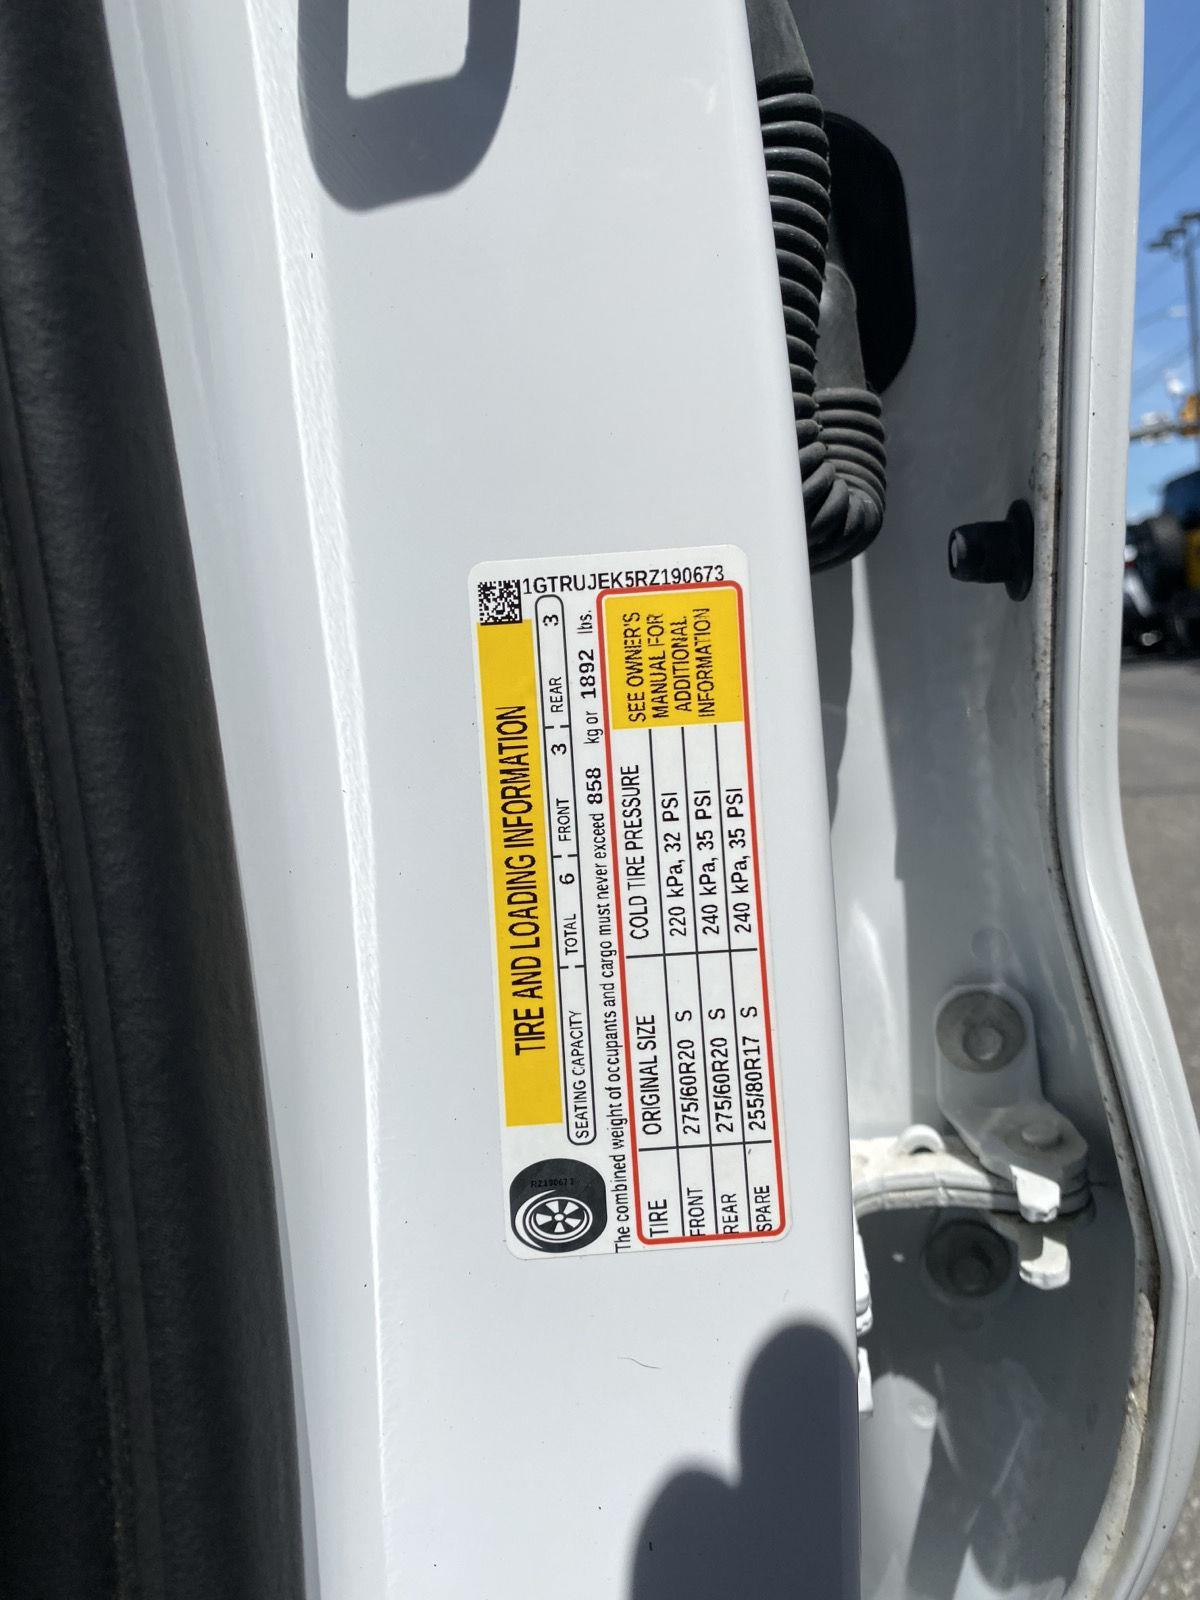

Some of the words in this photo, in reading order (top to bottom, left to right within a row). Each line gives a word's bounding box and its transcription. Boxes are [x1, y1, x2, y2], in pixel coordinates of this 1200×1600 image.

[523, 565, 724, 594] 1GTRUJEK5RZ190673
[543, 614, 559, 626] 3
[577, 610, 593, 635] lbs.
[646, 613, 665, 647] FOR
[622, 611, 645, 687] OWNER'S
[670, 616, 693, 712] ADDITIONAL
[692, 608, 716, 717] INFORMATION
[578, 649, 597, 699] 1892
[649, 650, 669, 718] MANUAL
[549, 676, 563, 713] REAR
[627, 692, 646, 723] SEE
[584, 728, 603, 744] kg
[587, 711, 599, 725] or
[551, 743, 567, 755] 3
[496, 705, 535, 848] INFORMATION
[586, 767, 602, 805] 858
[556, 798, 571, 842] FRONT
[620, 764, 644, 851] PRESSURE
[660, 792, 679, 822] PSI
[694, 790, 712, 820] PSI
[725, 788, 744, 818] PSI
[589, 813, 606, 859] exceed
[664, 832, 681, 853] 32
[697, 830, 714, 851] 35
[729, 828, 746, 848] 35
[559, 873, 575, 885] 6
[594, 862, 609, 900] never
[625, 855, 646, 889] TIRE
[666, 859, 685, 898] kPa,
[699, 858, 718, 896] kPa,
[730, 855, 750, 893] kPa,
[504, 854, 541, 950] LOADING
[597, 903, 612, 935] must
[628, 895, 649, 940] COLD
[701, 904, 720, 935] 240
[734, 902, 751, 933] 240
[565, 913, 578, 956] TOTAL
[668, 906, 687, 937] 220
[510, 956, 543, 999] AND
[600, 942, 617, 977] cargo
[599, 983, 616, 1009] and
[675, 1009, 692, 1021] S
[708, 1007, 725, 1020] S
[740, 1006, 758, 1018] S
[515, 1007, 546, 1056] TIRE
[569, 1010, 585, 1076] CAPACITY
[604, 1010, 623, 1081] occupants
[635, 1014, 656, 1051] SIZE
[605, 1083, 621, 1099] of
[638, 1055, 662, 1135] ORIGINAL
[678, 1039, 700, 1135] 275/60R20
[710, 1037, 733, 1133] 275/60R20
[742, 1036, 766, 1131] 255/80R17
[573, 1080, 589, 1138] SEATING
[606, 1103, 628, 1150] weight
[608, 1154, 629, 1222] combined
[647, 1199, 669, 1237] TIRE
[687, 1187, 706, 1237] FRONT
[721, 1193, 738, 1235] REAR
[754, 1185, 773, 1233] SPARE
[614, 1227, 632, 1253] The
